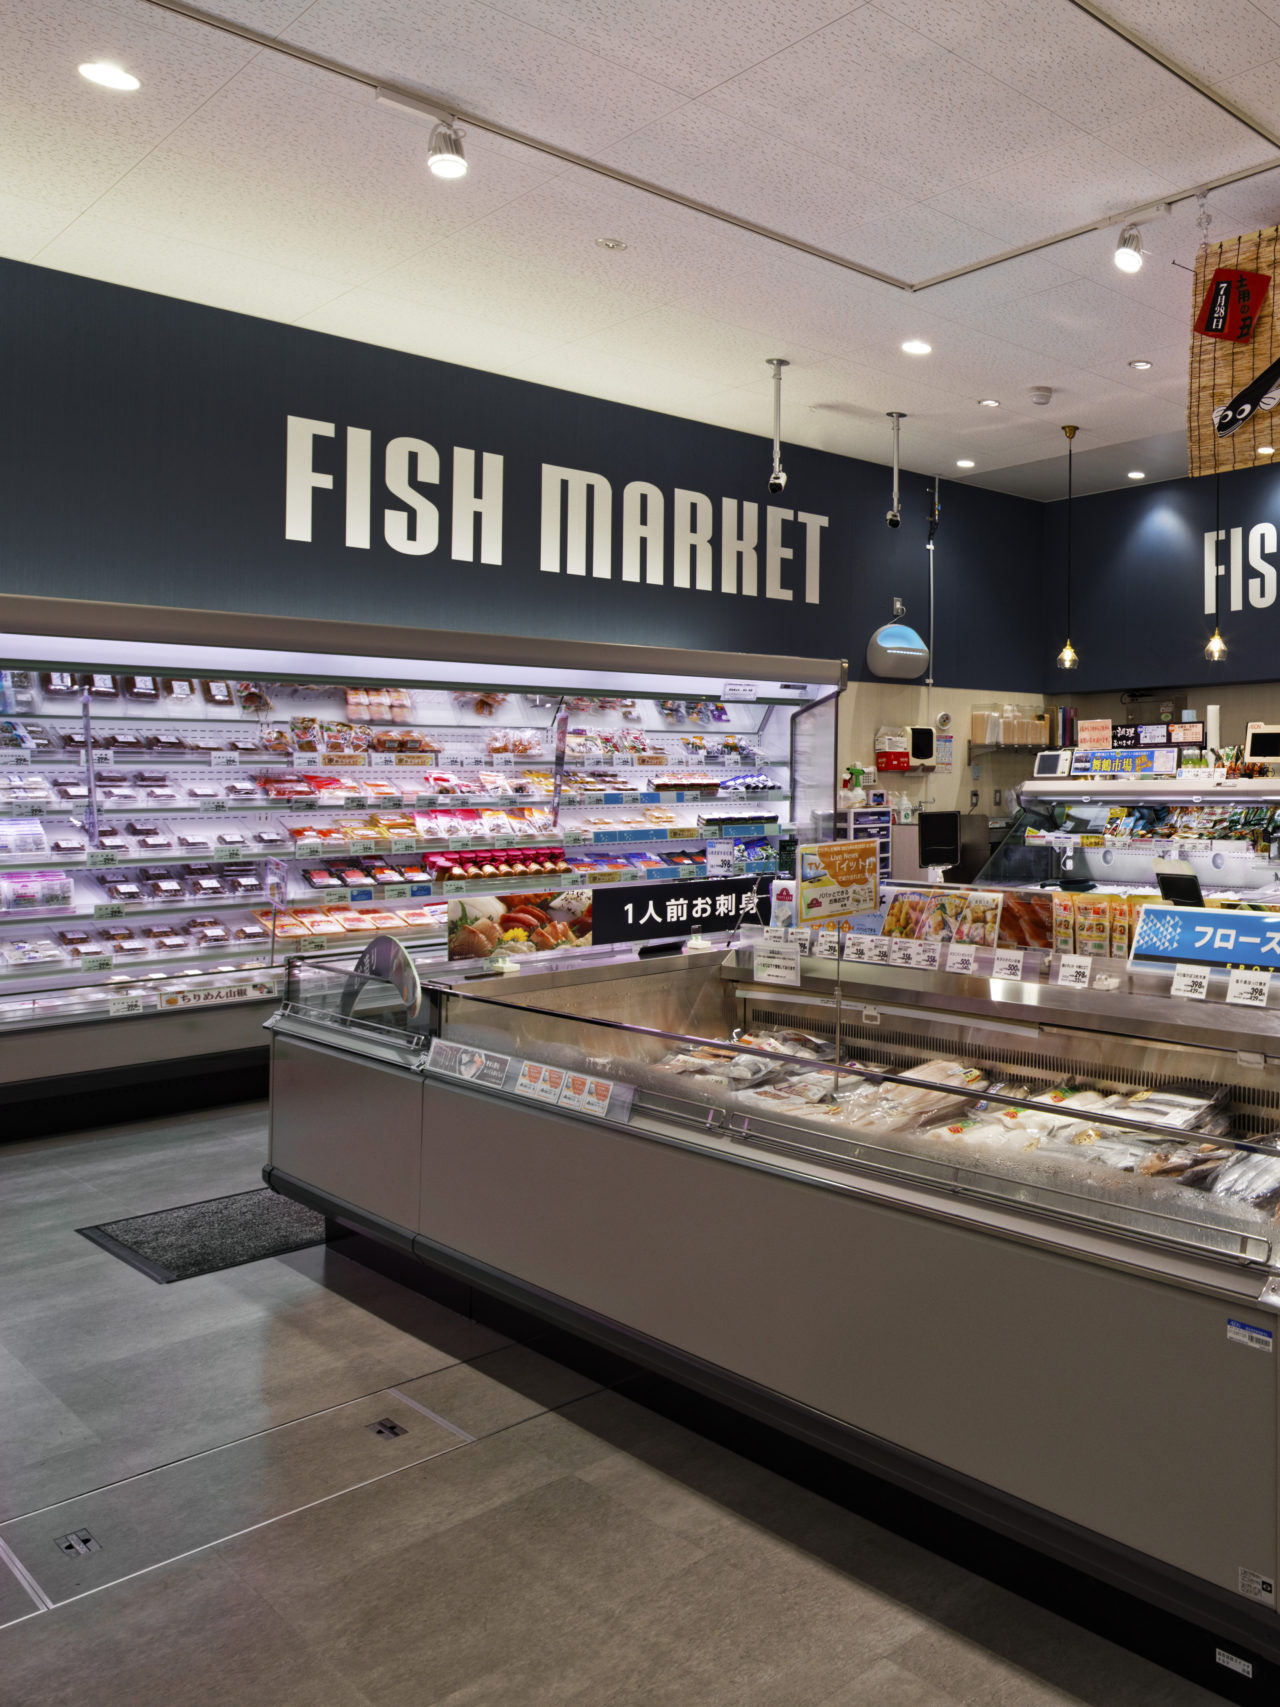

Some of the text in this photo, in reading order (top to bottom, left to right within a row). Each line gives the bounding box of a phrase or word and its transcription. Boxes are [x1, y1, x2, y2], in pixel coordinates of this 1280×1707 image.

[1212, 283, 1228, 329] 7月28日
[1236, 274, 1253, 339] 土用の丑
[285, 414, 829, 605] FISH MARKET
[1091, 757, 1133, 772] 舞鶴市場
[807, 862, 820, 871] TV
[624, 892, 759, 925] 1人前お刺身
[180, 987, 248, 1003] ちりめん山椒
